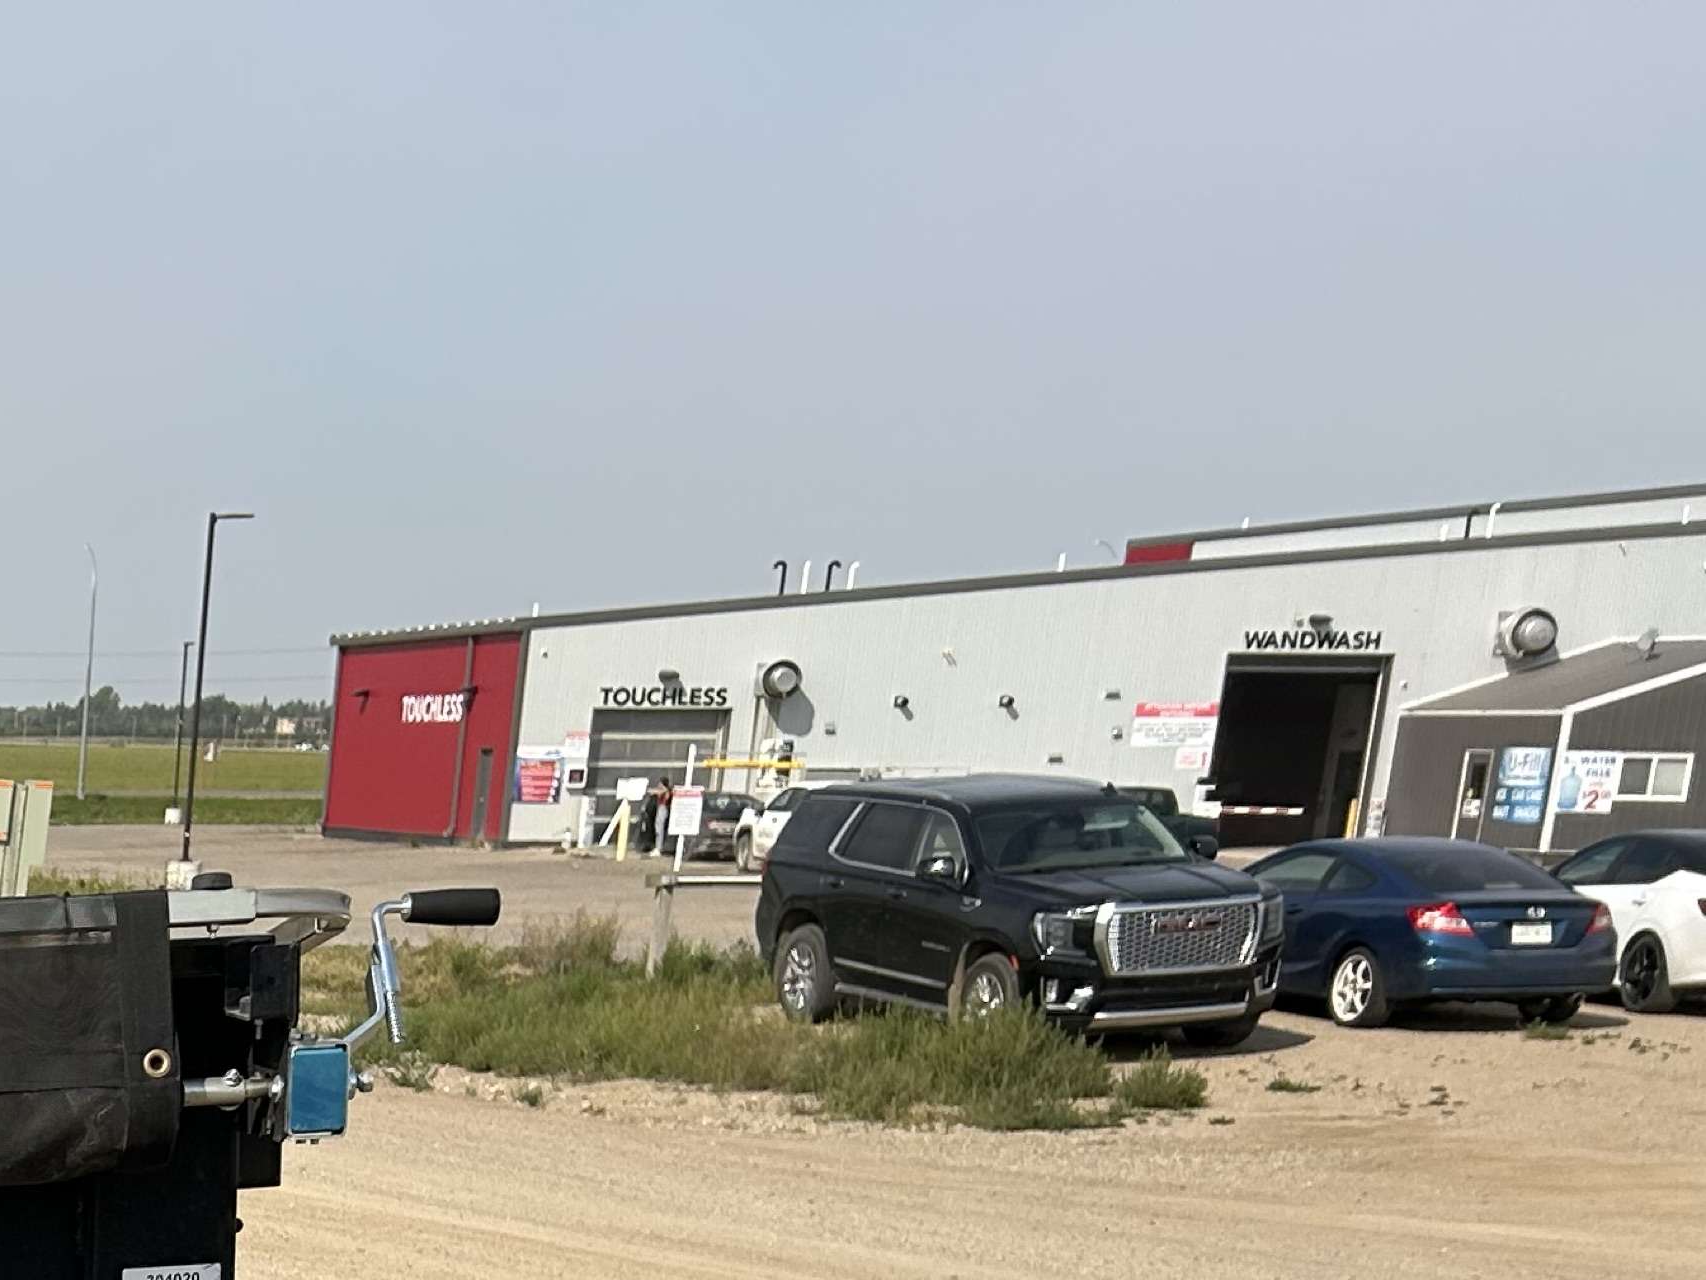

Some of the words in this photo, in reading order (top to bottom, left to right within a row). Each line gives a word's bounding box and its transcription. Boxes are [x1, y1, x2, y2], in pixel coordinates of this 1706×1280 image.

[1244, 630, 1383, 650] WANDWASH
[600, 687, 728, 706] TOUCHLESS
[401, 693, 464, 723] TOUCHLESS
